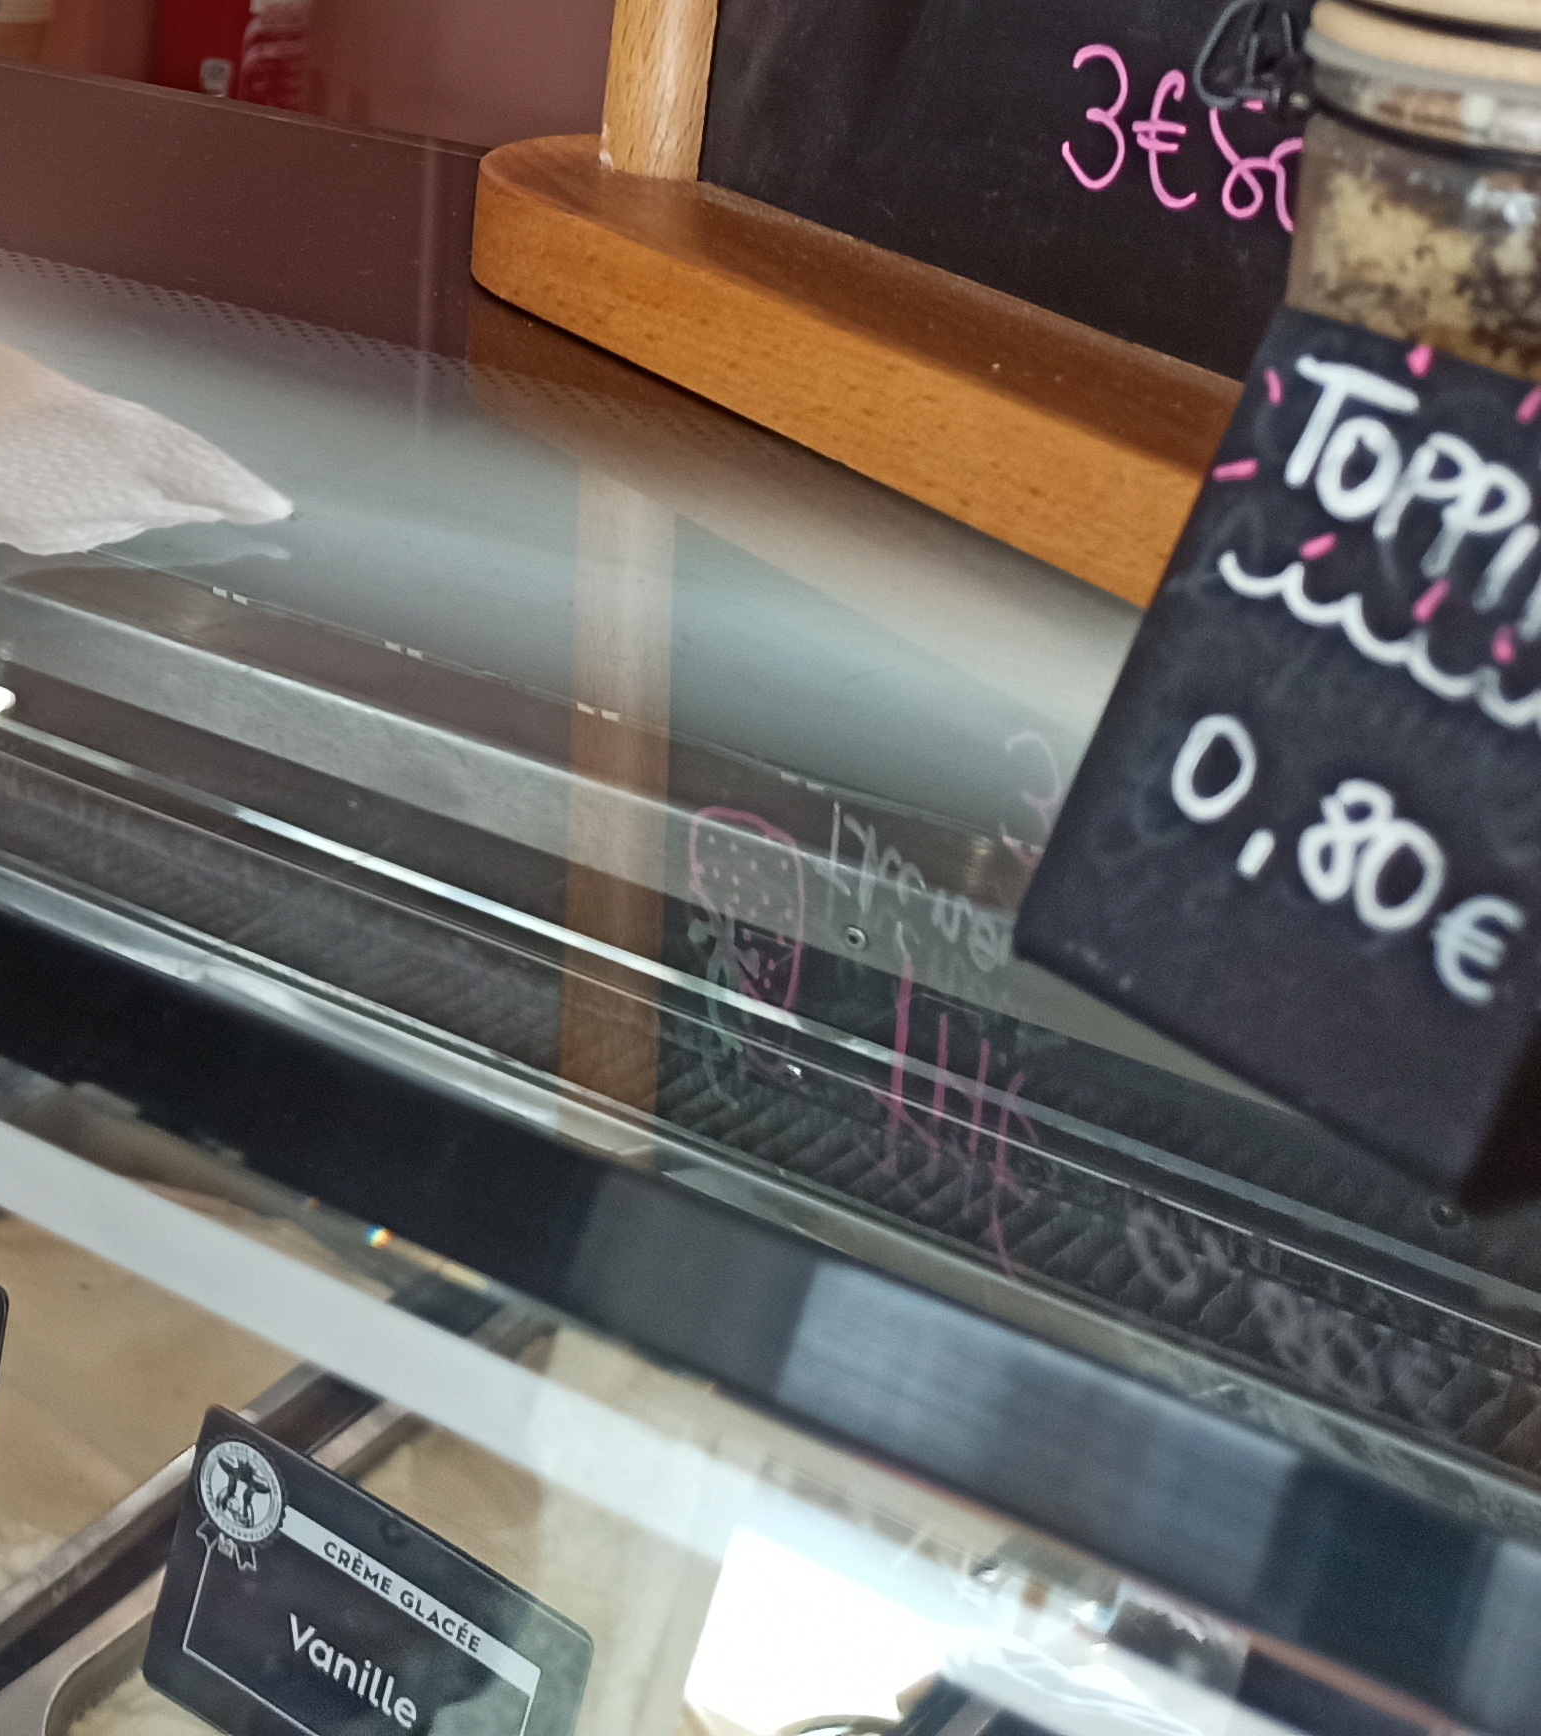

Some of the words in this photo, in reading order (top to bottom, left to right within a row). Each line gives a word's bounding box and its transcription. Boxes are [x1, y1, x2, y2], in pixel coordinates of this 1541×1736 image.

[323, 1540, 394, 1596] CRÈME
[399, 1589, 481, 1654] GLACÉE
[289, 1612, 418, 1729] Vanille
